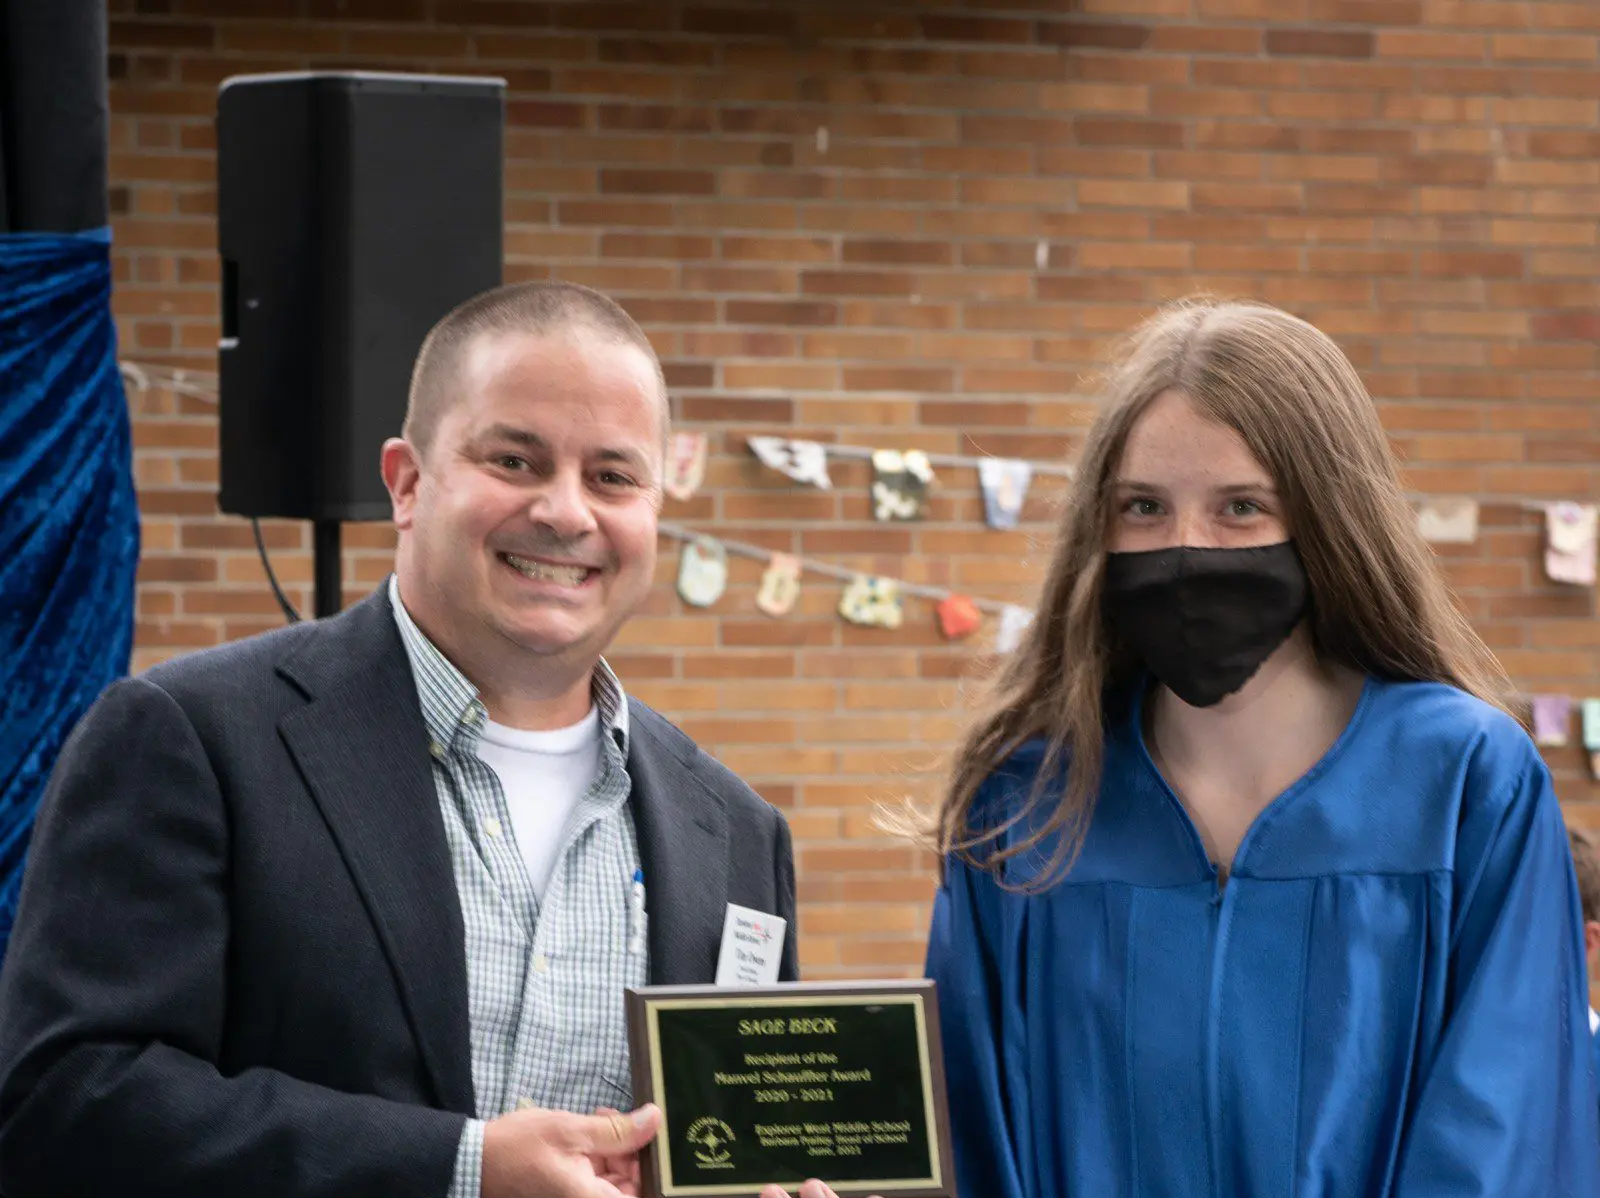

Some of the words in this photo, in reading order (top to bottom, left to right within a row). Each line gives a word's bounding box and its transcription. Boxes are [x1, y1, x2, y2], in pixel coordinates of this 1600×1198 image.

[738, 1019, 785, 1035] SAGE
[788, 1017, 837, 1034] BECK
[744, 1053, 800, 1067] Recipient
[802, 1052, 815, 1063] of
[817, 1051, 838, 1063] the
[831, 1068, 871, 1082] Award
[754, 1089, 790, 1102] 2020
[800, 1088, 833, 1101] 2021
[832, 1122, 870, 1133] Middle
[871, 1120, 911, 1132] School
[873, 1132, 908, 1143] School
